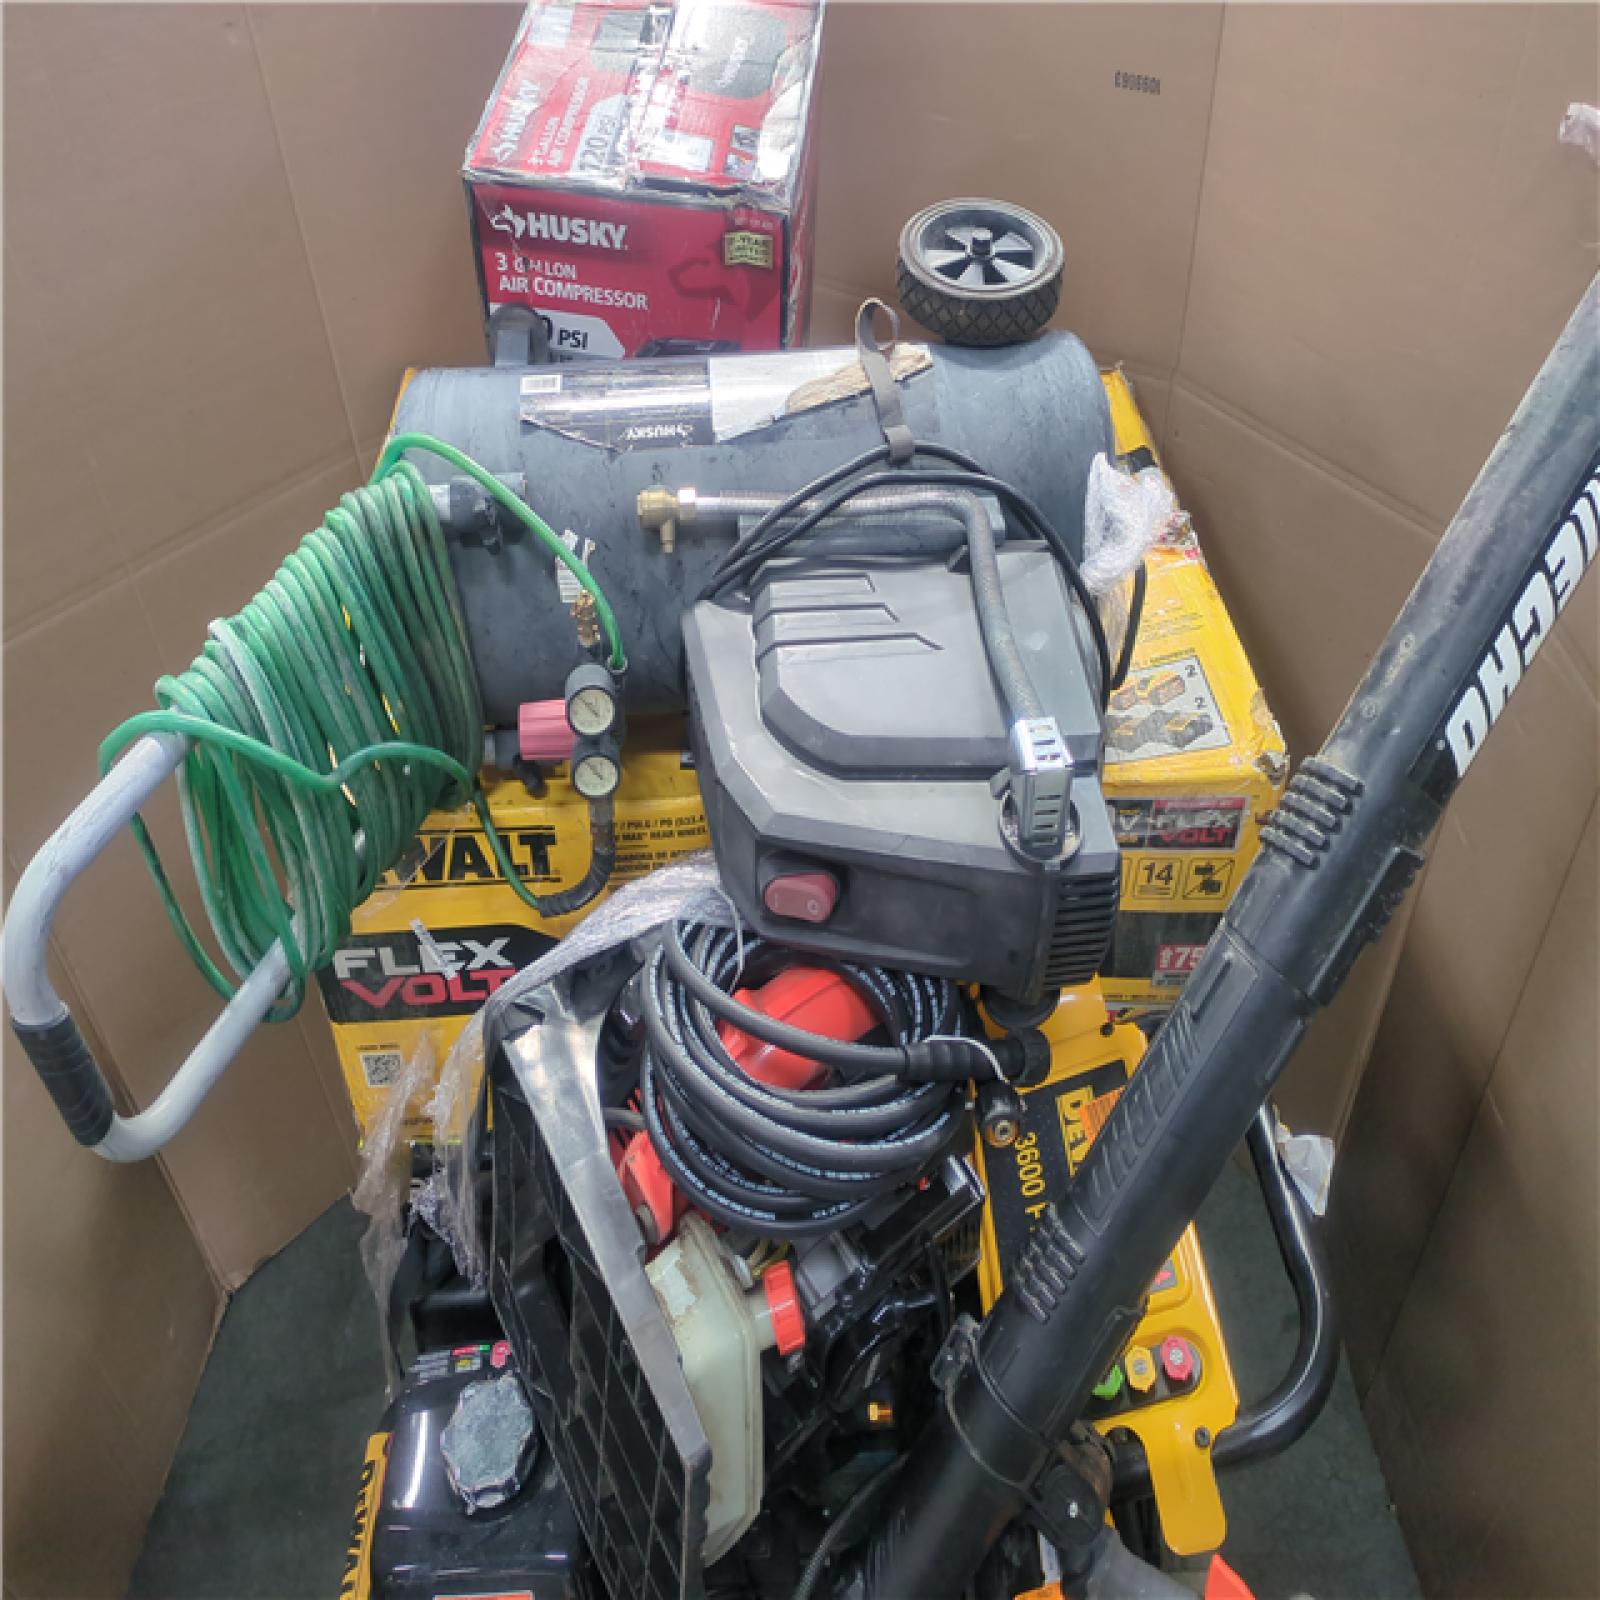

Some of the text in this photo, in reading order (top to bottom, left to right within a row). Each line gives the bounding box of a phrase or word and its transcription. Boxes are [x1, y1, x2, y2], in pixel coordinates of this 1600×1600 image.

[527, 211, 627, 249] HUSKY
[494, 252, 508, 271] 3
[500, 275, 648, 310] AIR COMPRESSOR
[558, 327, 588, 348] PSI
[385, 833, 557, 885] WALT
[1142, 861, 1173, 885] 14
[335, 937, 514, 978] FLEX
[339, 968, 518, 1008] VOLT
[1013, 1130, 1046, 1197] 3600
